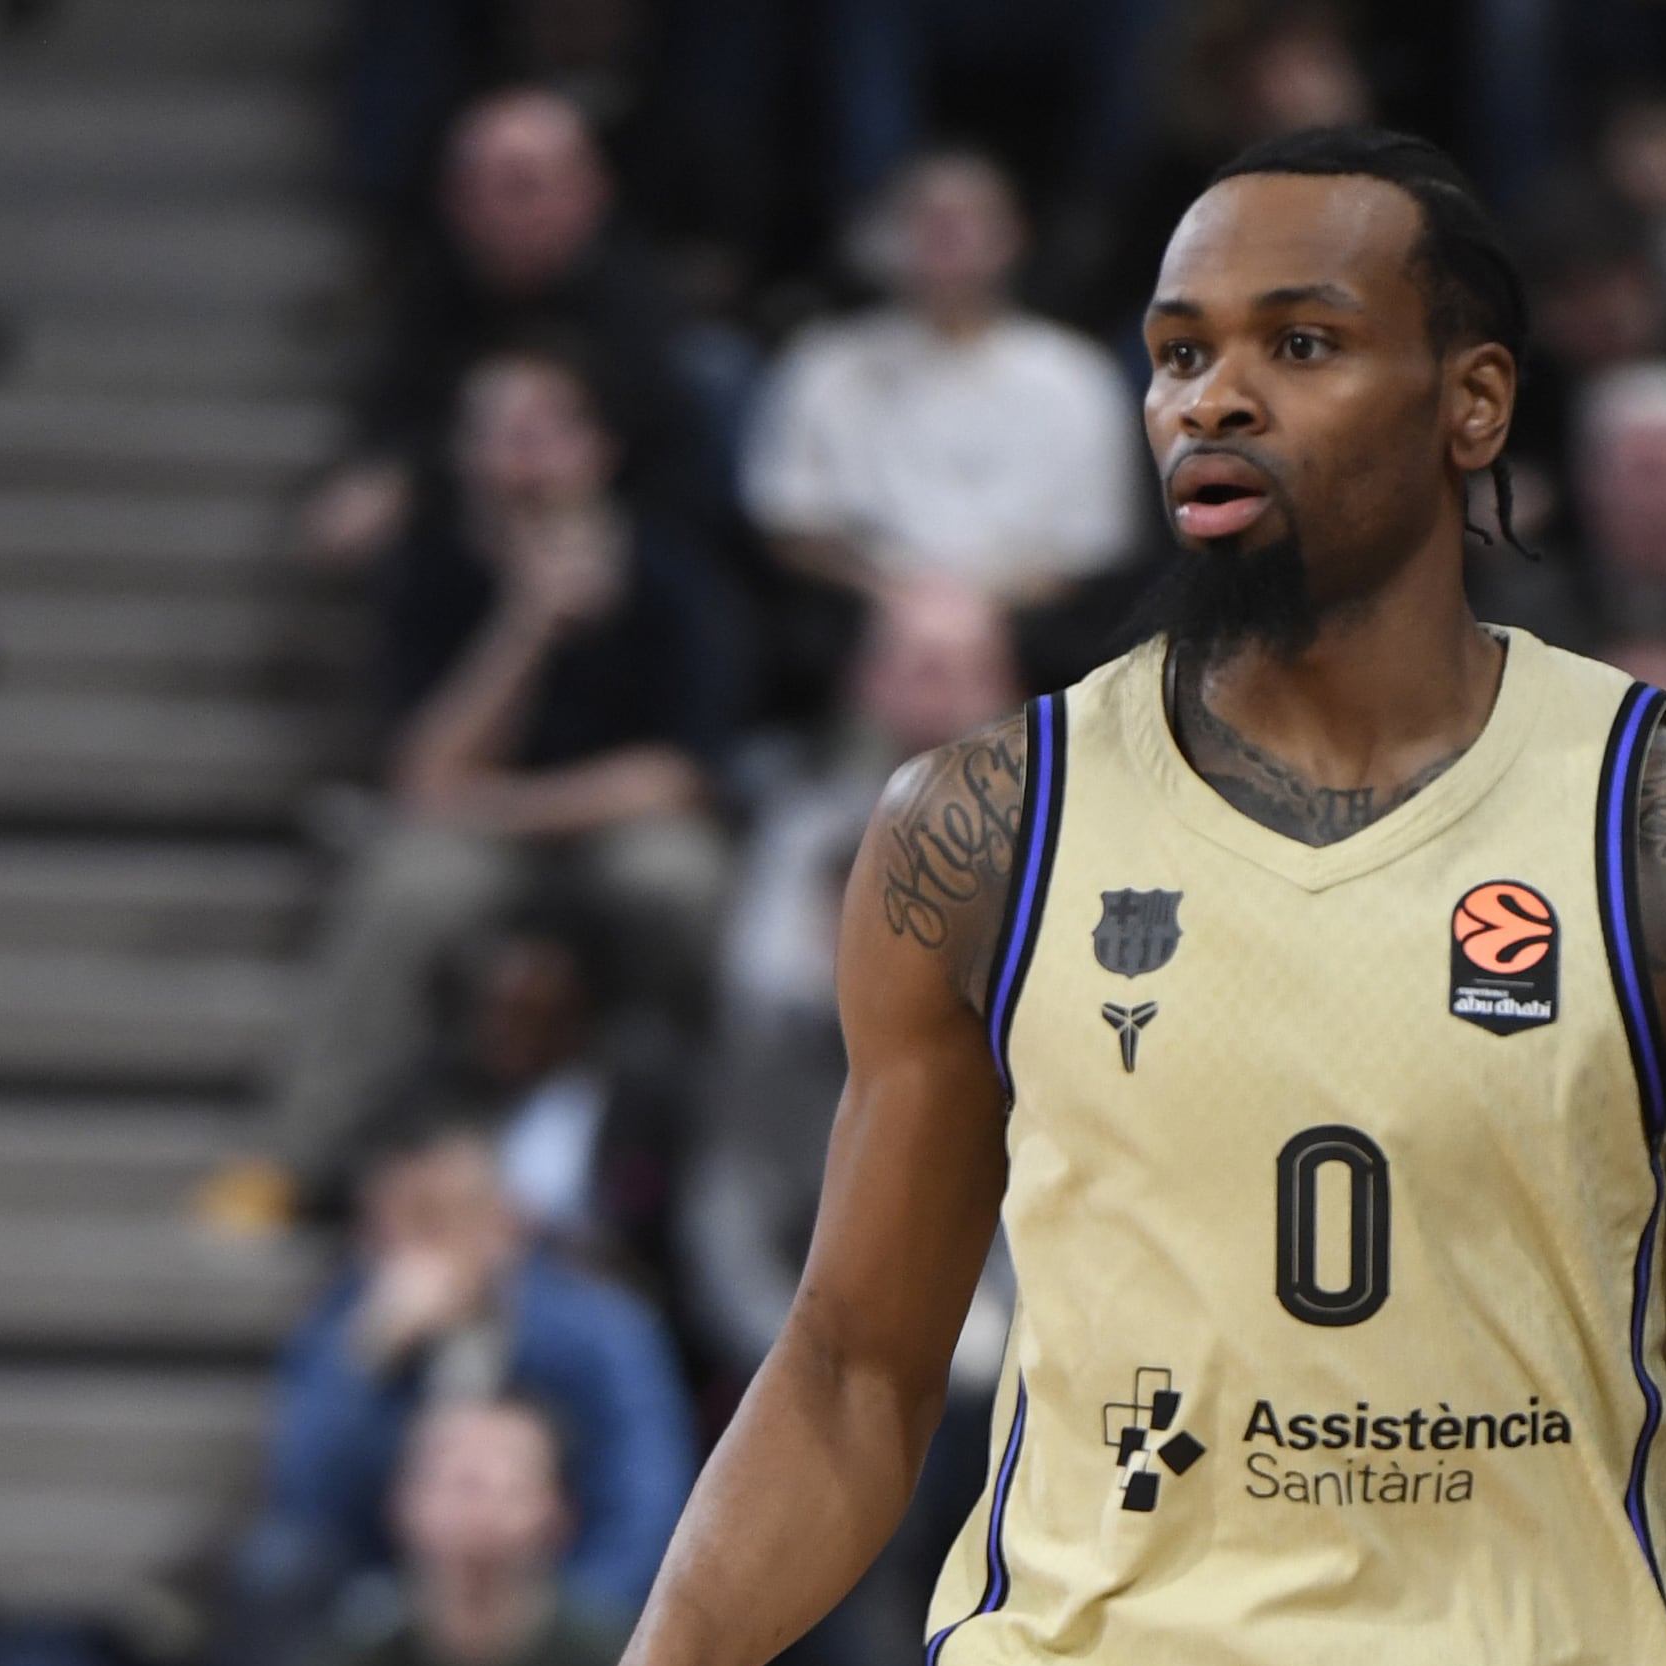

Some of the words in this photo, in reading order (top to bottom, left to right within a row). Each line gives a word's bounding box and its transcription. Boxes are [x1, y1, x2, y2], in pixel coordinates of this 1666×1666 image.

[1276, 1124, 1390, 1327] 0
[1243, 1397, 1572, 1451] Assistència
[1246, 1452, 1475, 1506] Sanitària
